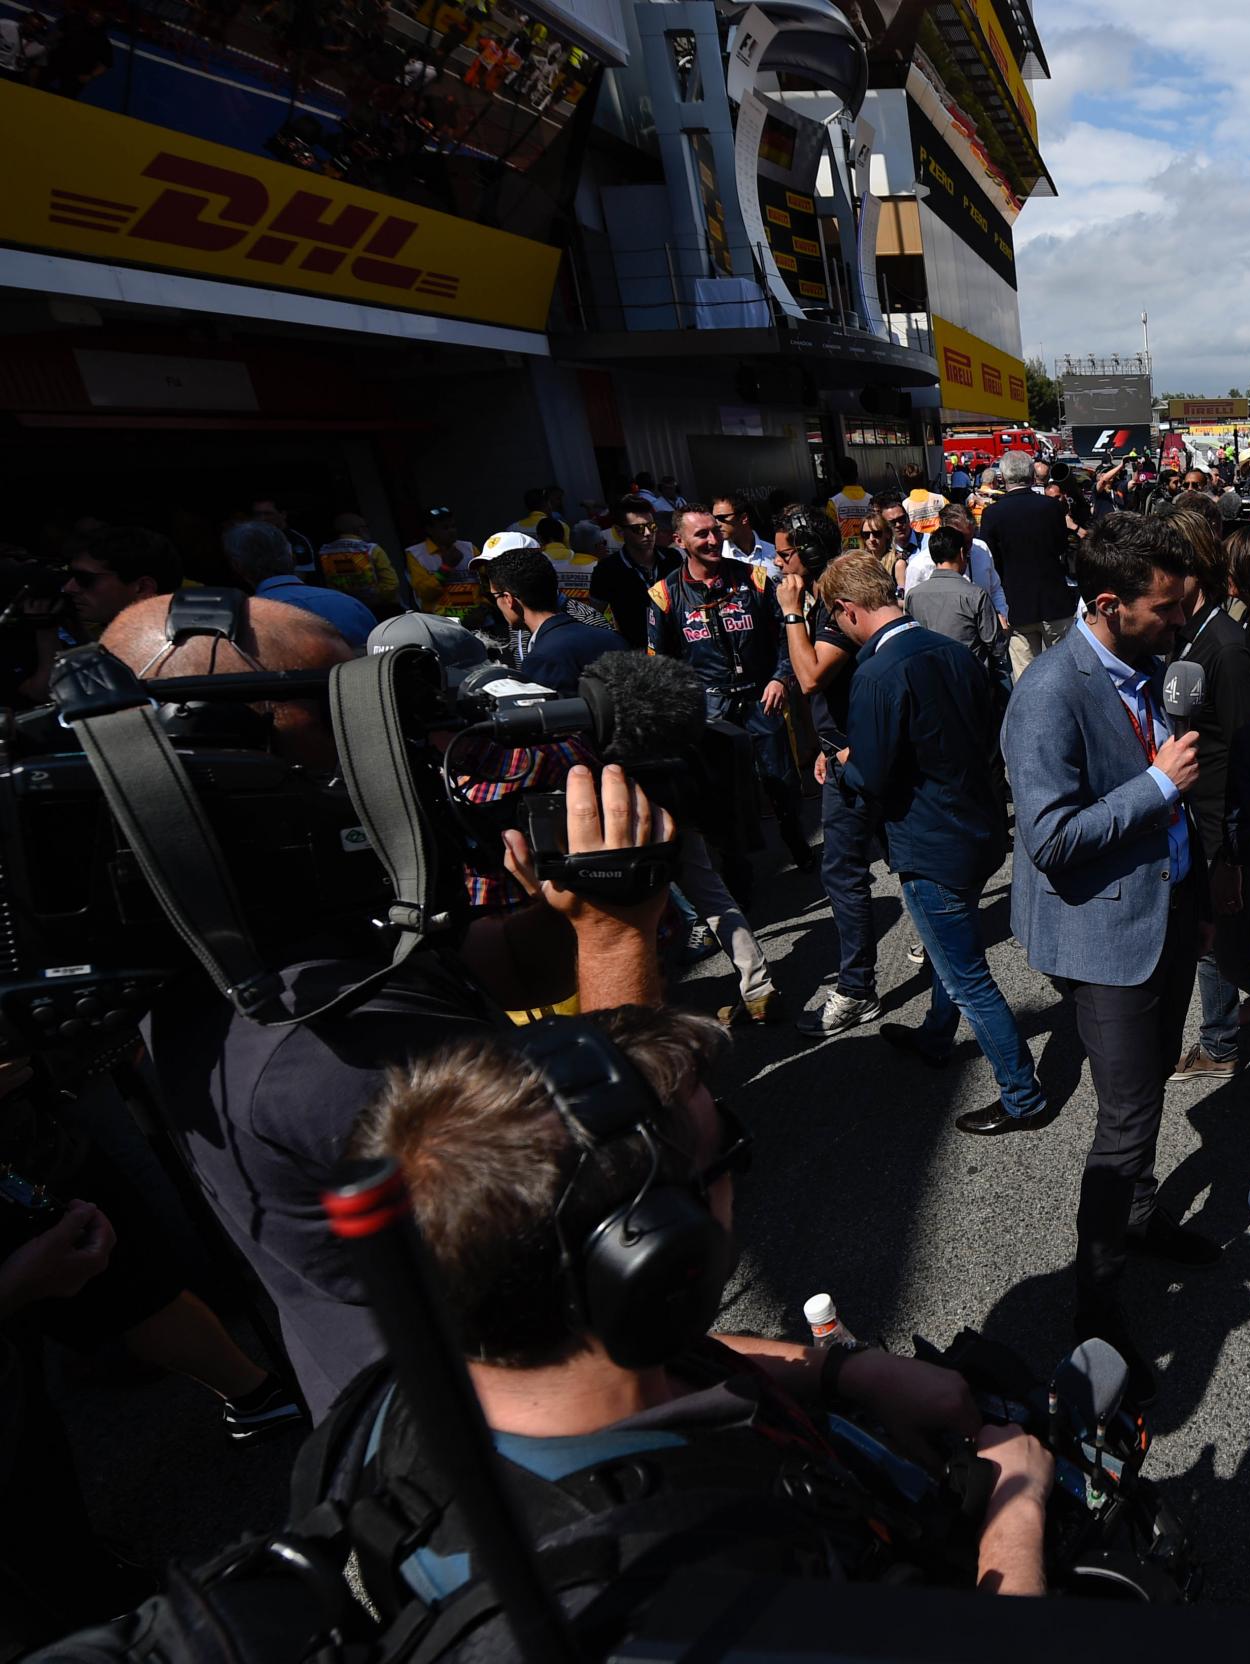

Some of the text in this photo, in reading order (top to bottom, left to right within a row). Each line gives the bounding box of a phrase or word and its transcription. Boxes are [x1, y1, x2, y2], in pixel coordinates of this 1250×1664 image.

[929, 156, 955, 196] ZERO
[129, 152, 422, 290] DHL
[970, 203, 988, 233] ZERO
[943, 346, 1024, 402] PIRELLI PIRELLI PIRELLI
[1184, 402, 1234, 415] PIRELLI
[684, 615, 753, 642] Red Bull
[1165, 676, 1180, 703] 4
[578, 868, 623, 879] Canon
